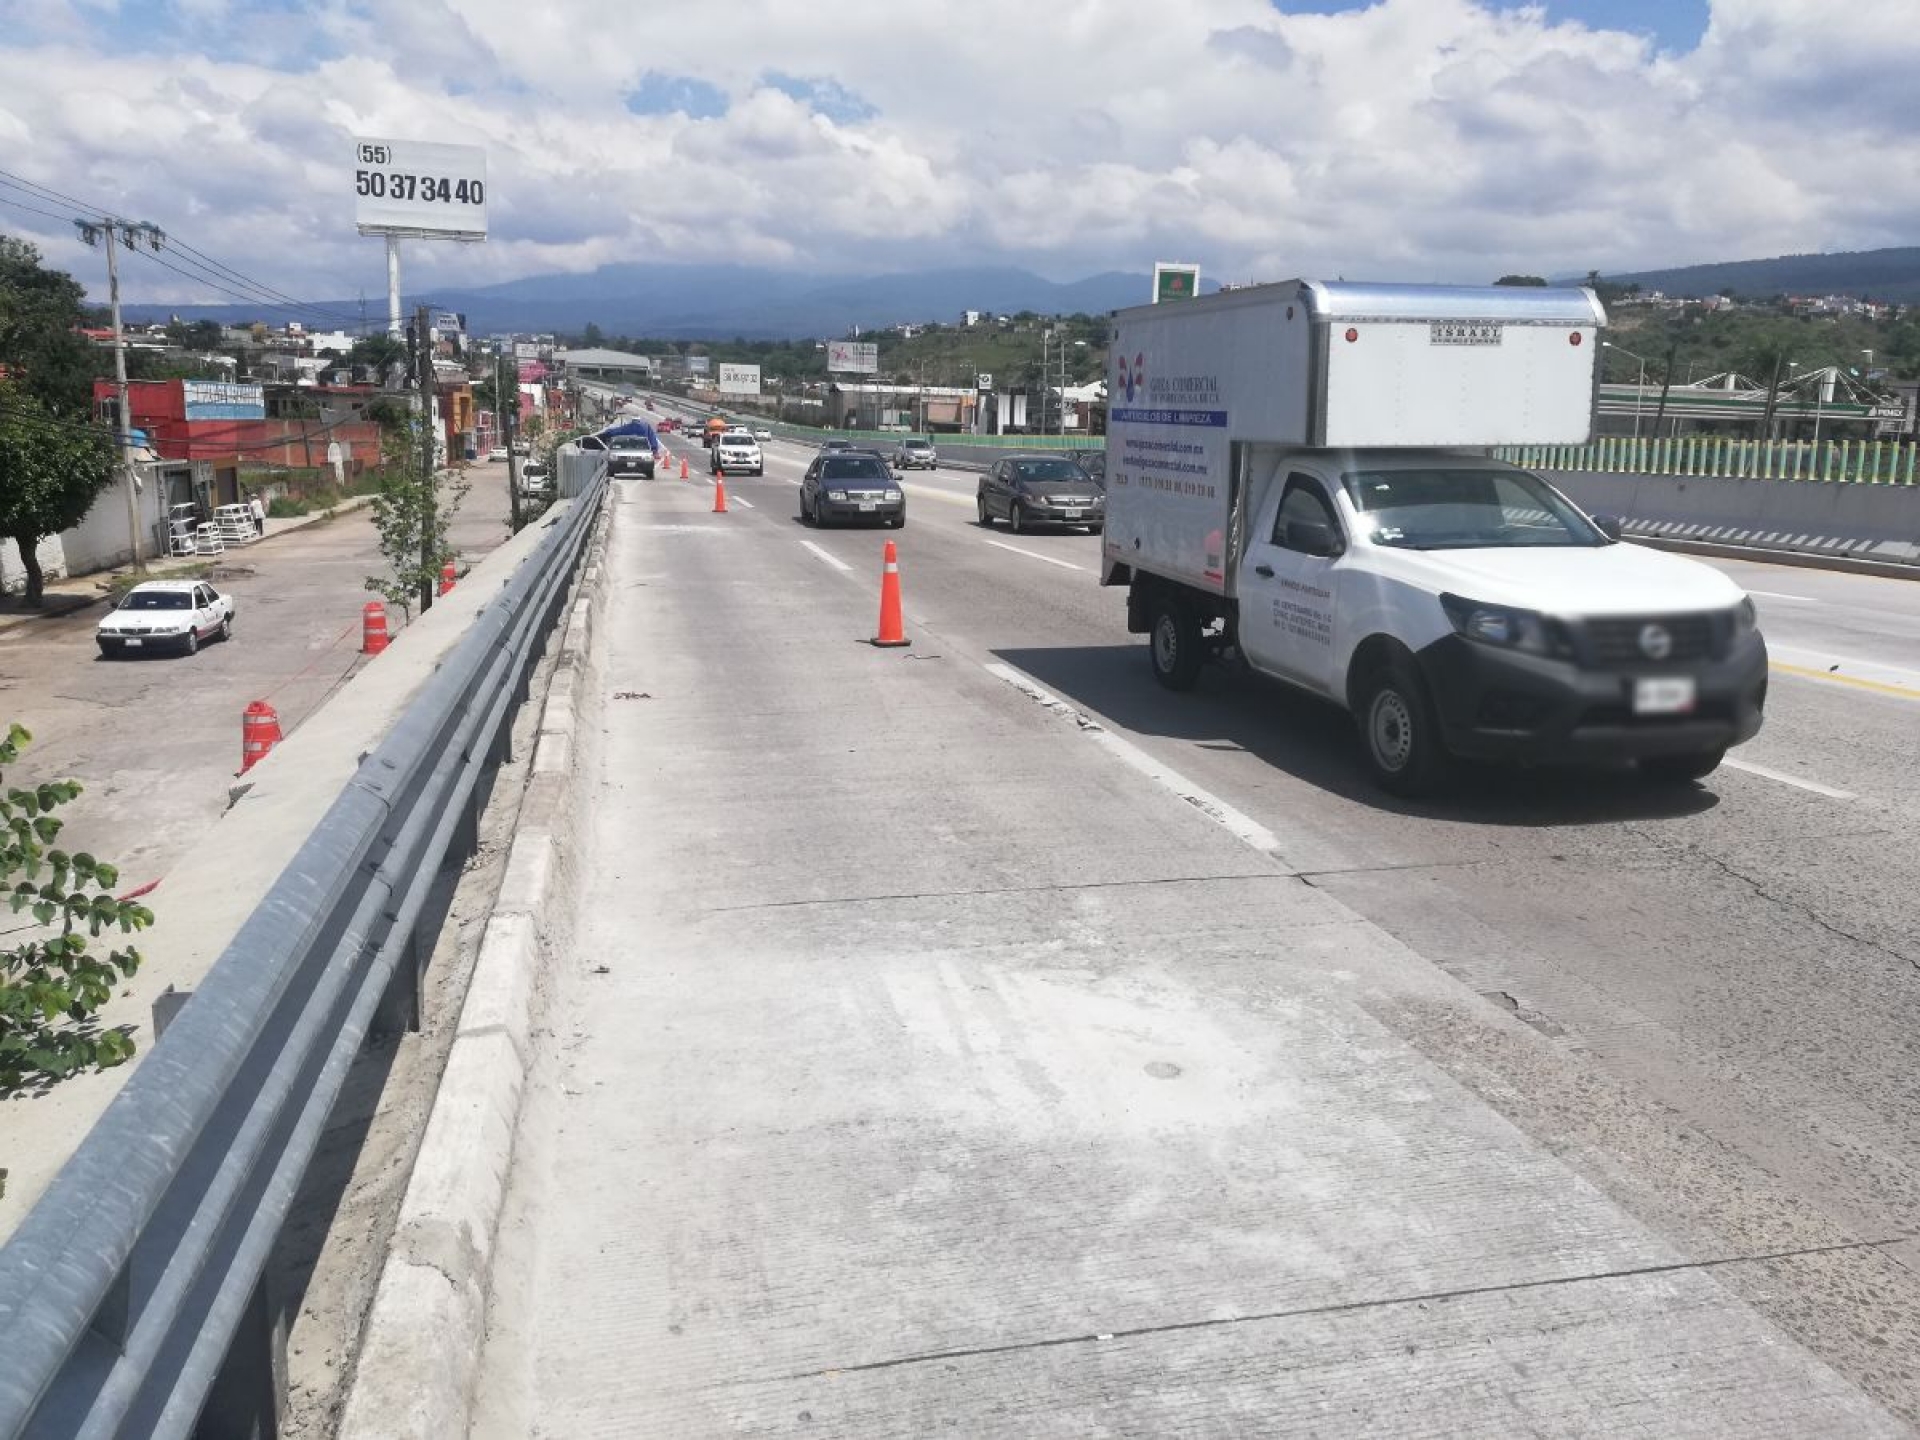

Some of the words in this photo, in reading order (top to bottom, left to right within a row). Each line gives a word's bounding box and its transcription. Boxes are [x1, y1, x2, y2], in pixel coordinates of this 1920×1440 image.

[357, 143, 391, 165] (55)
[1172, 376, 1217, 392] COMERCIAL
[1161, 412, 1172, 422] DE
[1174, 412, 1212, 424] LIMPIEZA
